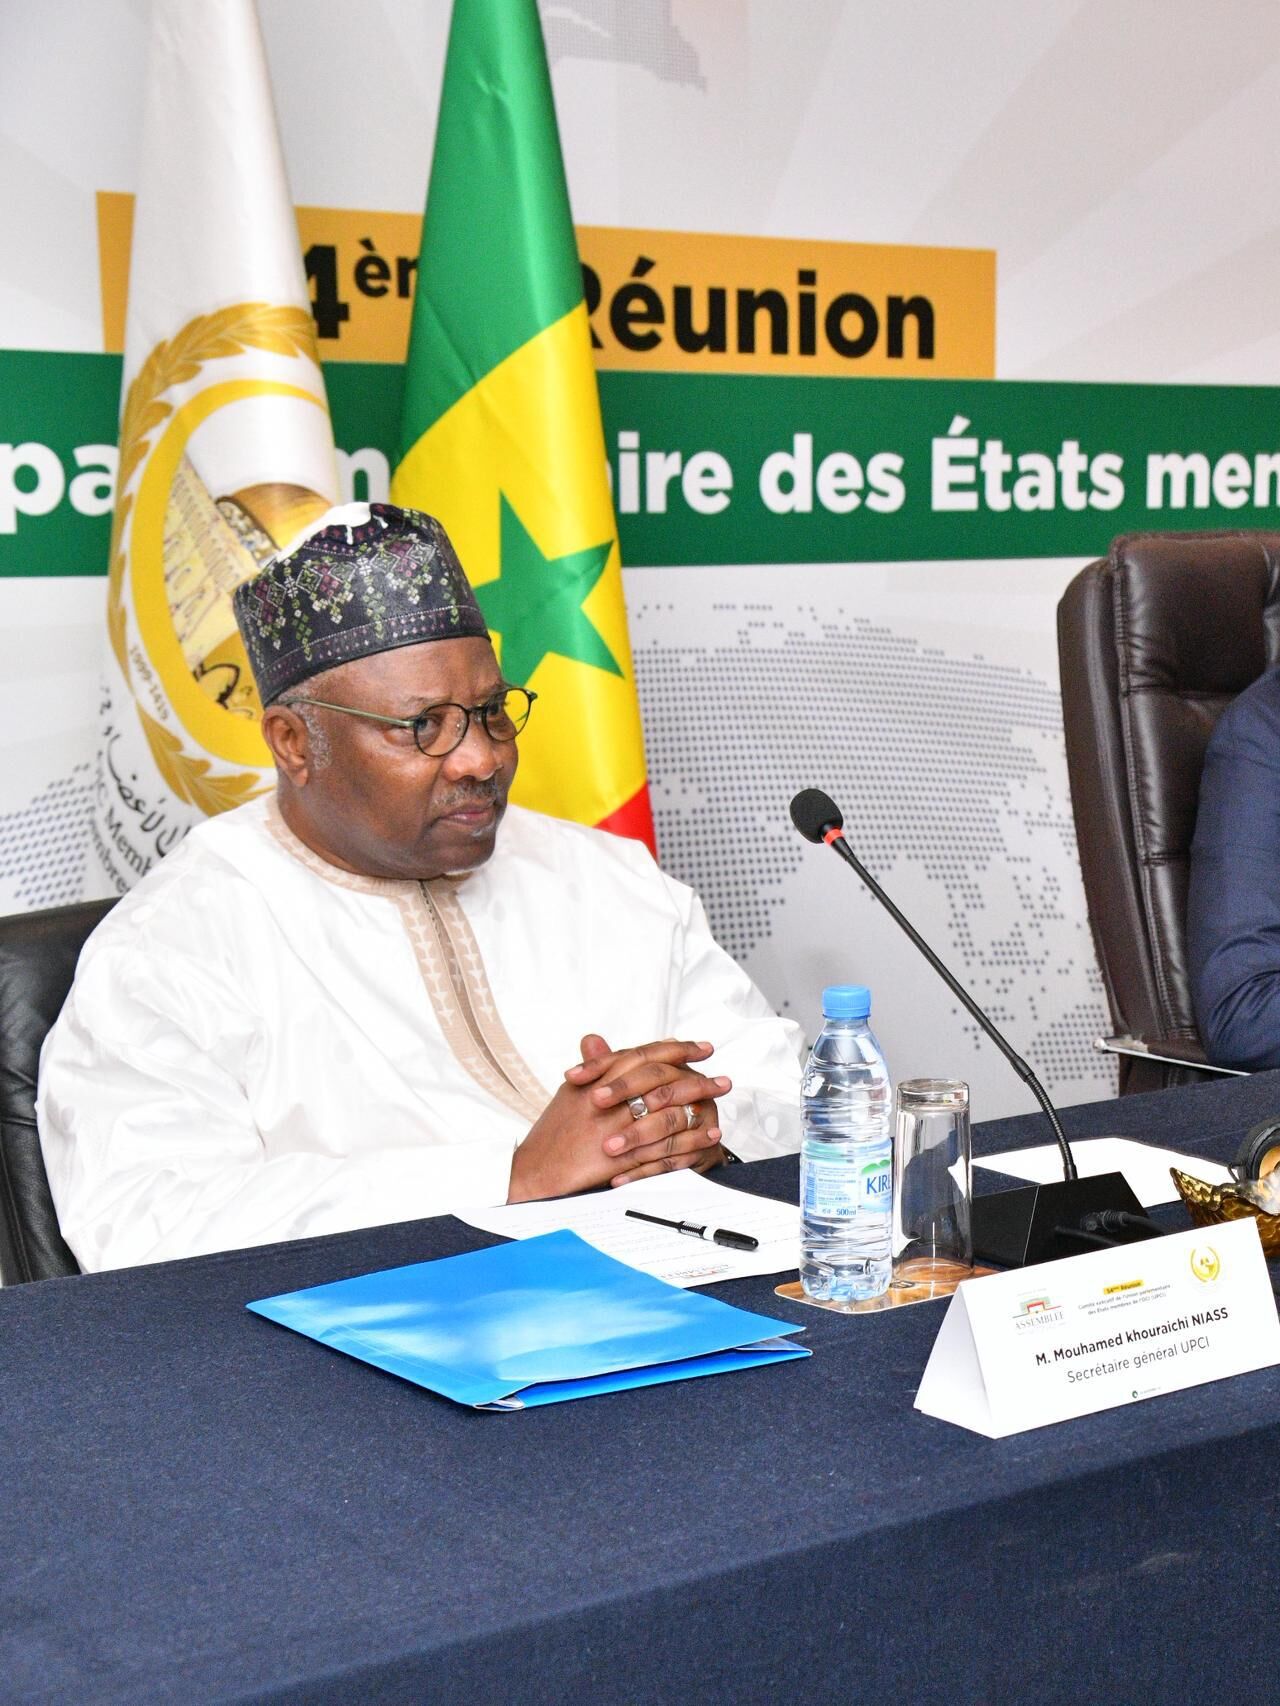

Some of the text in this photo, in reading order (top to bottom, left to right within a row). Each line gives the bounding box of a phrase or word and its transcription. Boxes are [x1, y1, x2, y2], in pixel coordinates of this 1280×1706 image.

[758, 432, 906, 513] des
[931, 414, 1125, 512] États
[1035, 1307, 1229, 1366] M. Mouhamed khouraichi NIASS
[1067, 1336, 1210, 1383] Secrétaire général UPCI
